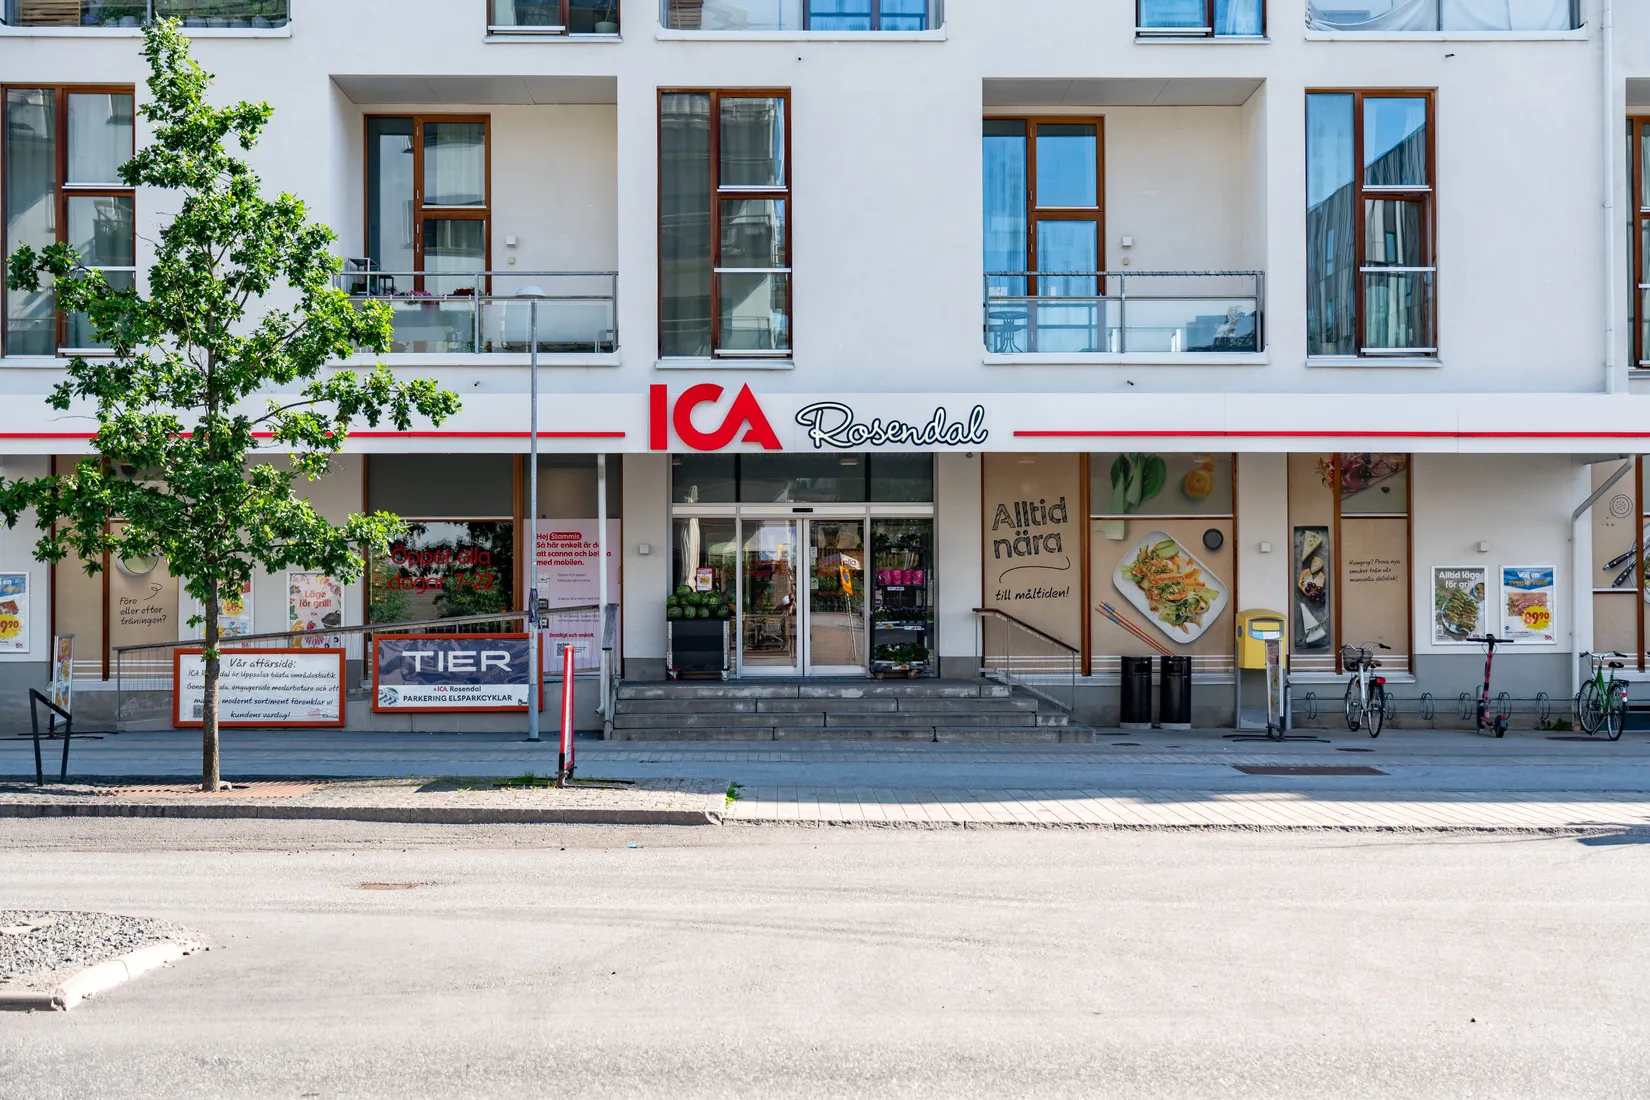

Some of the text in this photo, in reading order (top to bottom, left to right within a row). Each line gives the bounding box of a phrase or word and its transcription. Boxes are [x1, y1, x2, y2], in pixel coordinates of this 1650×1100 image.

[649, 382, 989, 451] ICA Rosendal
[992, 496, 1068, 531] Alltid
[536, 533, 548, 541] Hej
[993, 530, 1062, 559] nära
[391, 543, 491, 568] Öppet alla
[1439, 571, 1480, 581] Alltid läge
[1517, 571, 1530, 579] Välj
[387, 572, 495, 594] dagar 7-22
[1445, 580, 1457, 588] för
[304, 590, 326, 599] Läge
[995, 586, 1070, 600] till måltiden!
[119, 596, 138, 606] Före
[299, 599, 332, 609] för grill!
[120, 606, 163, 615] eller efter
[121, 614, 167, 627] träningen?
[229, 657, 297, 668] Vår affärsidé:
[402, 650, 512, 672] TIER
[187, 669, 199, 677] ICA
[241, 670, 269, 679] Uppsalas
[231, 684, 271, 692] engagerade
[253, 697, 289, 705] sortiment
[291, 697, 325, 705] förenklar
[449, 694, 513, 702] ELSPARKCYKLAR
[230, 710, 291, 720] kundens vardag!
